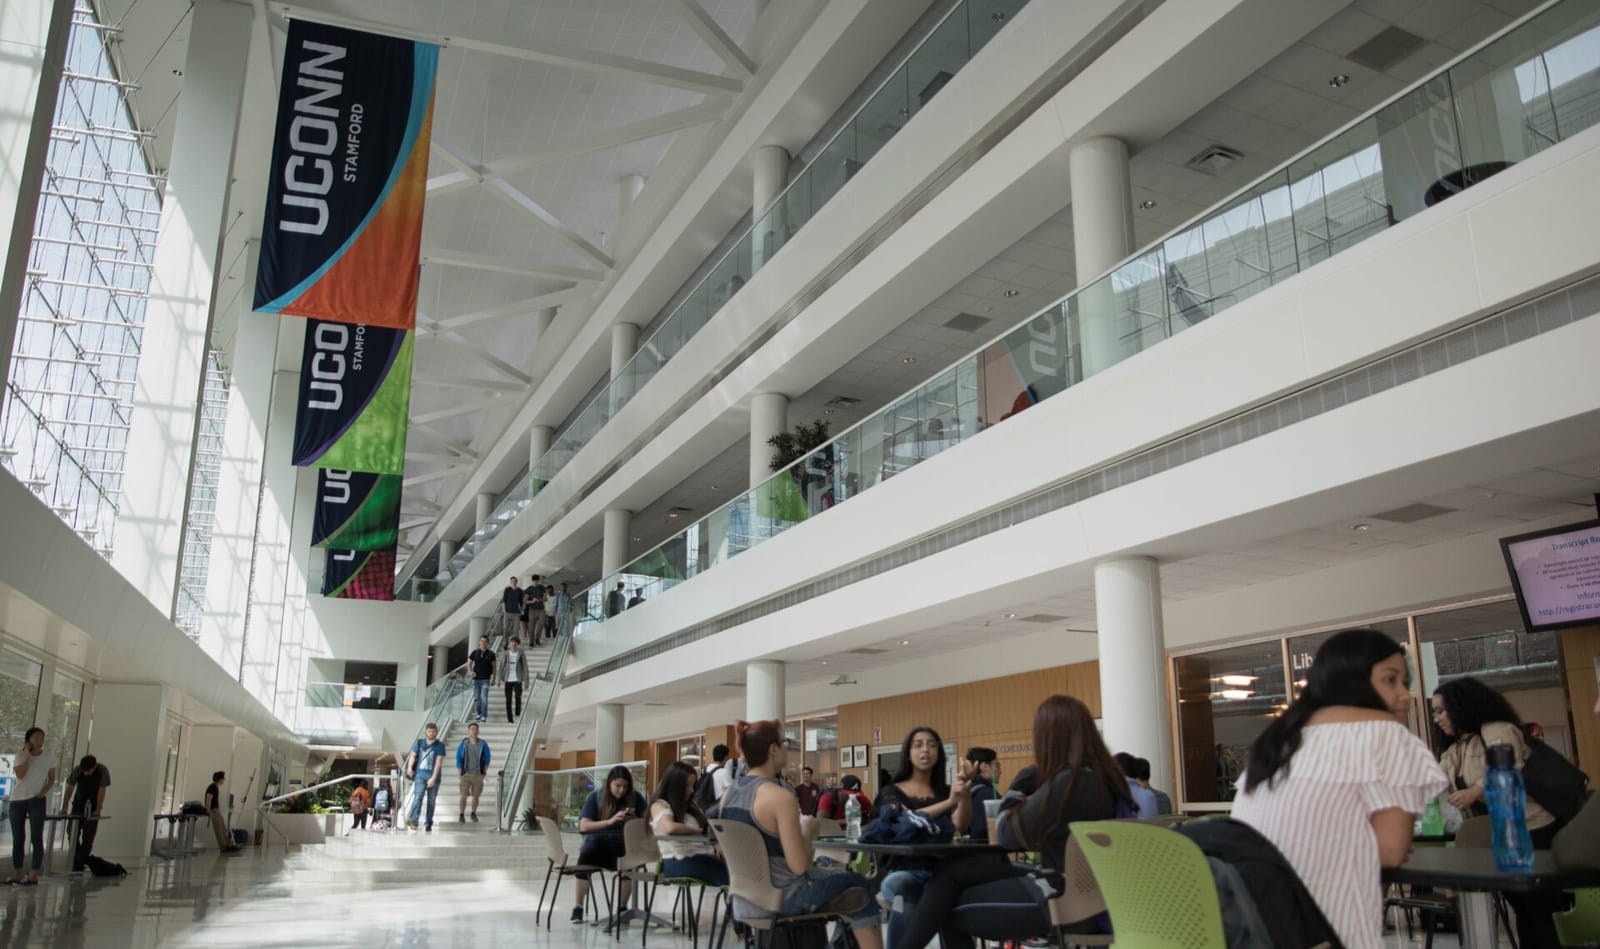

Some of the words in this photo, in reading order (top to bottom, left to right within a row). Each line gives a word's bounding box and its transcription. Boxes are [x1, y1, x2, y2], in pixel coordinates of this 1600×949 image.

[279, 40, 347, 236] UCONN
[344, 103, 364, 183] STAMFORD
[308, 322, 350, 411] UCO
[352, 323, 366, 370] STAMFO
